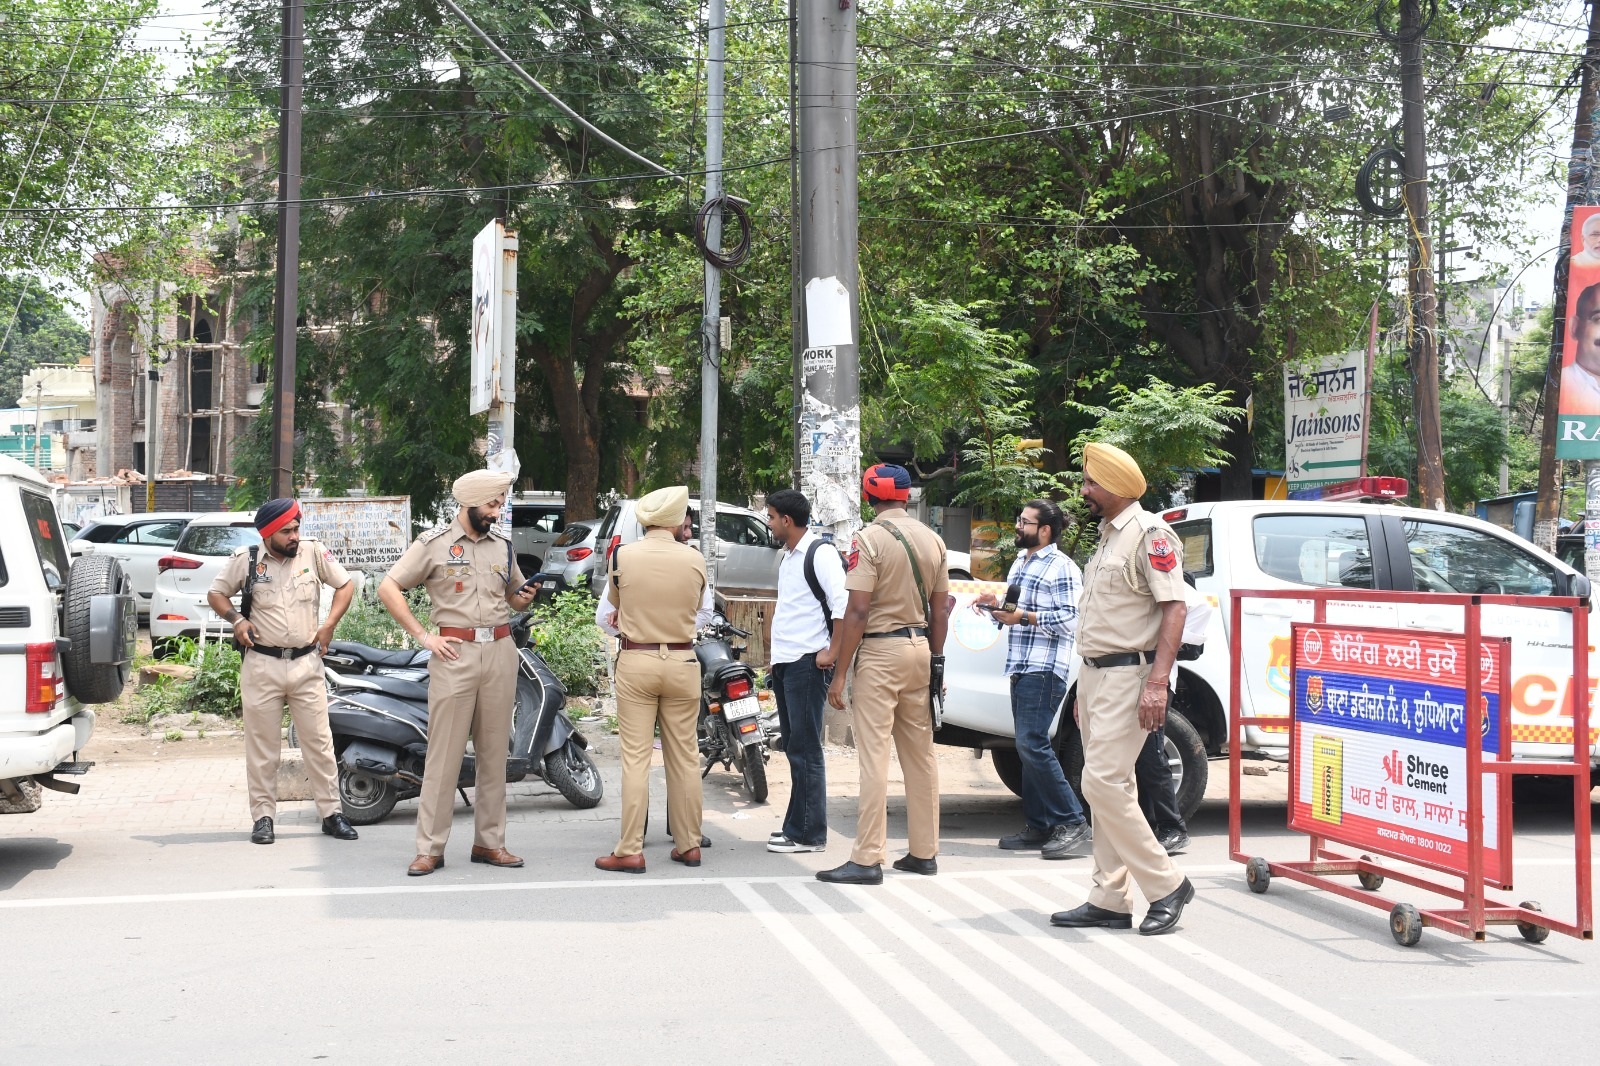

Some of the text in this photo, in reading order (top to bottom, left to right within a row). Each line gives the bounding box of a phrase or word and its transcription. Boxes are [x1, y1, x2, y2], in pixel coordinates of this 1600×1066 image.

[1287, 412, 1361, 444] Jainsons
[1305, 641, 1320, 653] STOP
[1383, 640, 1421, 669] ਲਈ
[1407, 754, 1449, 779] Shree
[1407, 774, 1447, 795] Cement
[1350, 786, 1371, 806] ਘਰ
[1375, 786, 1388, 810] ਦੀ
[1417, 836, 1434, 849] 1800
[1435, 841, 1452, 854] 1022
